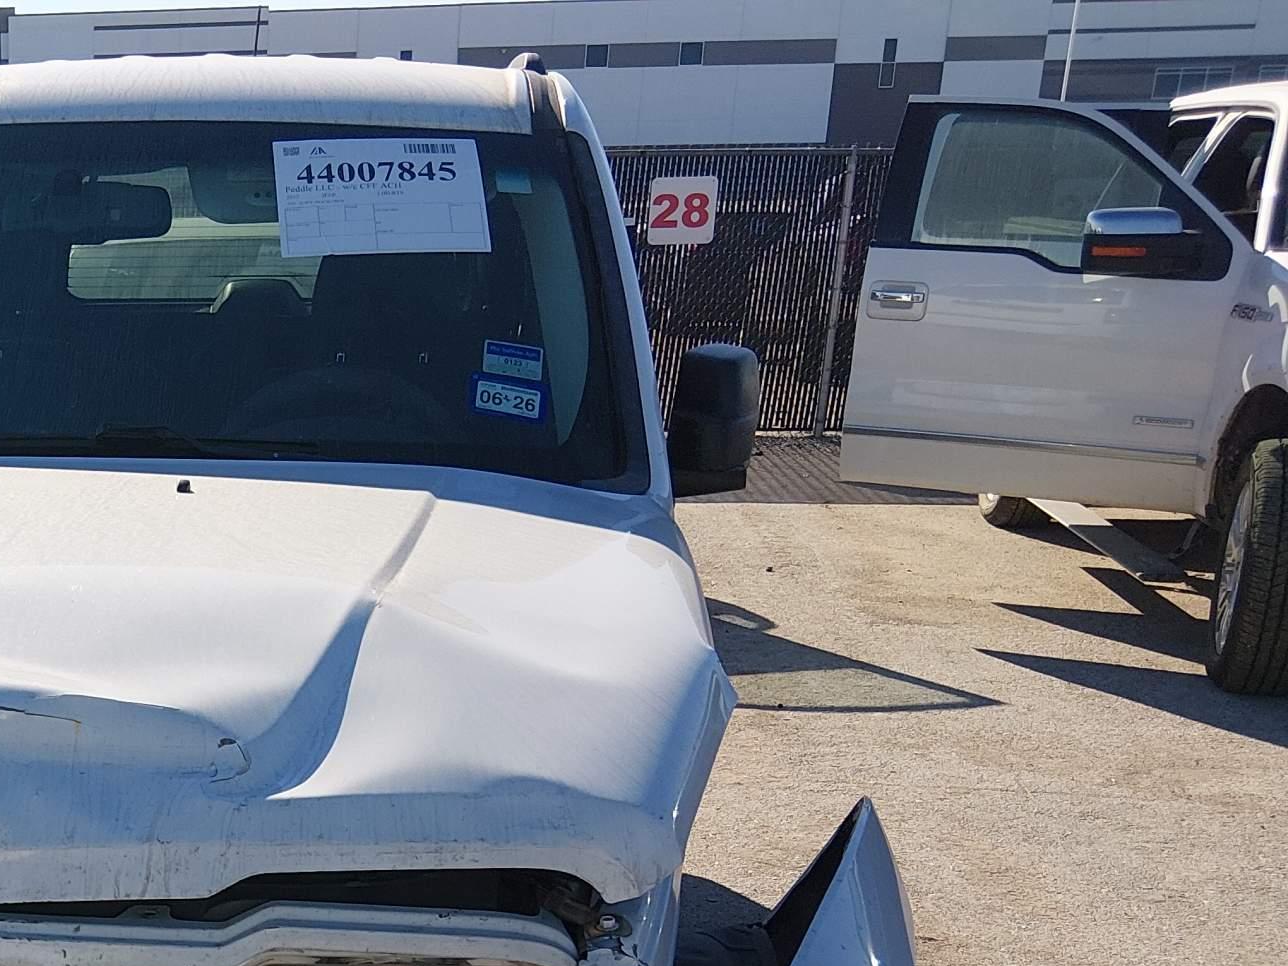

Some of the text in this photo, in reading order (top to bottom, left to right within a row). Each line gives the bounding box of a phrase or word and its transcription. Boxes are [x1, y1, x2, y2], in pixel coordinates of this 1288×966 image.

[297, 161, 457, 184] 44007845
[285, 183, 313, 194] Peddle
[315, 182, 336, 192] LLC
[650, 192, 710, 229] 28
[479, 389, 503, 406] 06
[512, 395, 536, 413] 26
